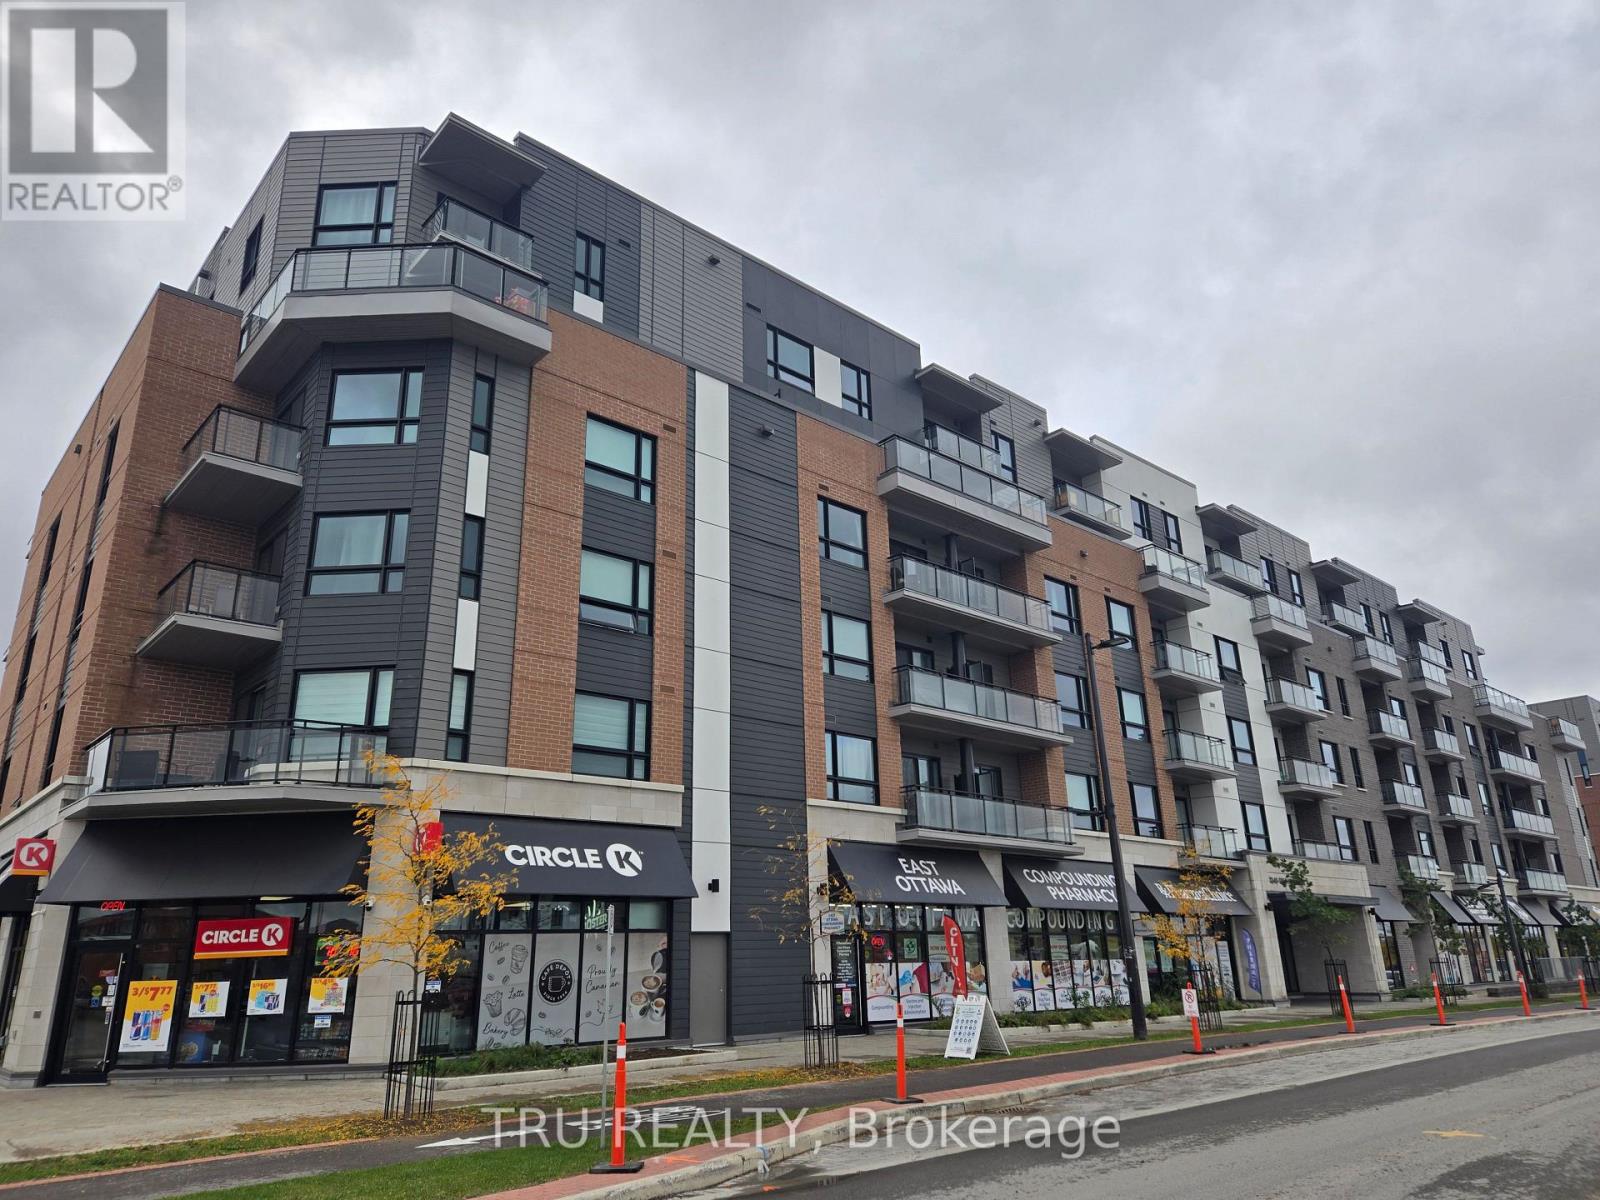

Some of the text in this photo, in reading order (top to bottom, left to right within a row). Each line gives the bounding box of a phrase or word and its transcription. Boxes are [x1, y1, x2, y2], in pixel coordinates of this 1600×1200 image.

[504, 844, 643, 877] CIRCLE K
[898, 858, 937, 876] EAST
[895, 875, 966, 896] OTTAWA
[1047, 886, 1118, 903] PHARMACY
[101, 901, 125, 911] OPEN
[584, 913, 608, 930] OSTER
[1007, 909, 1114, 930] COMPOUNDING
[201, 925, 283, 946] CIRCLE K
[587, 963, 618, 978] Prouly
[586, 980, 620, 994] Canaan
